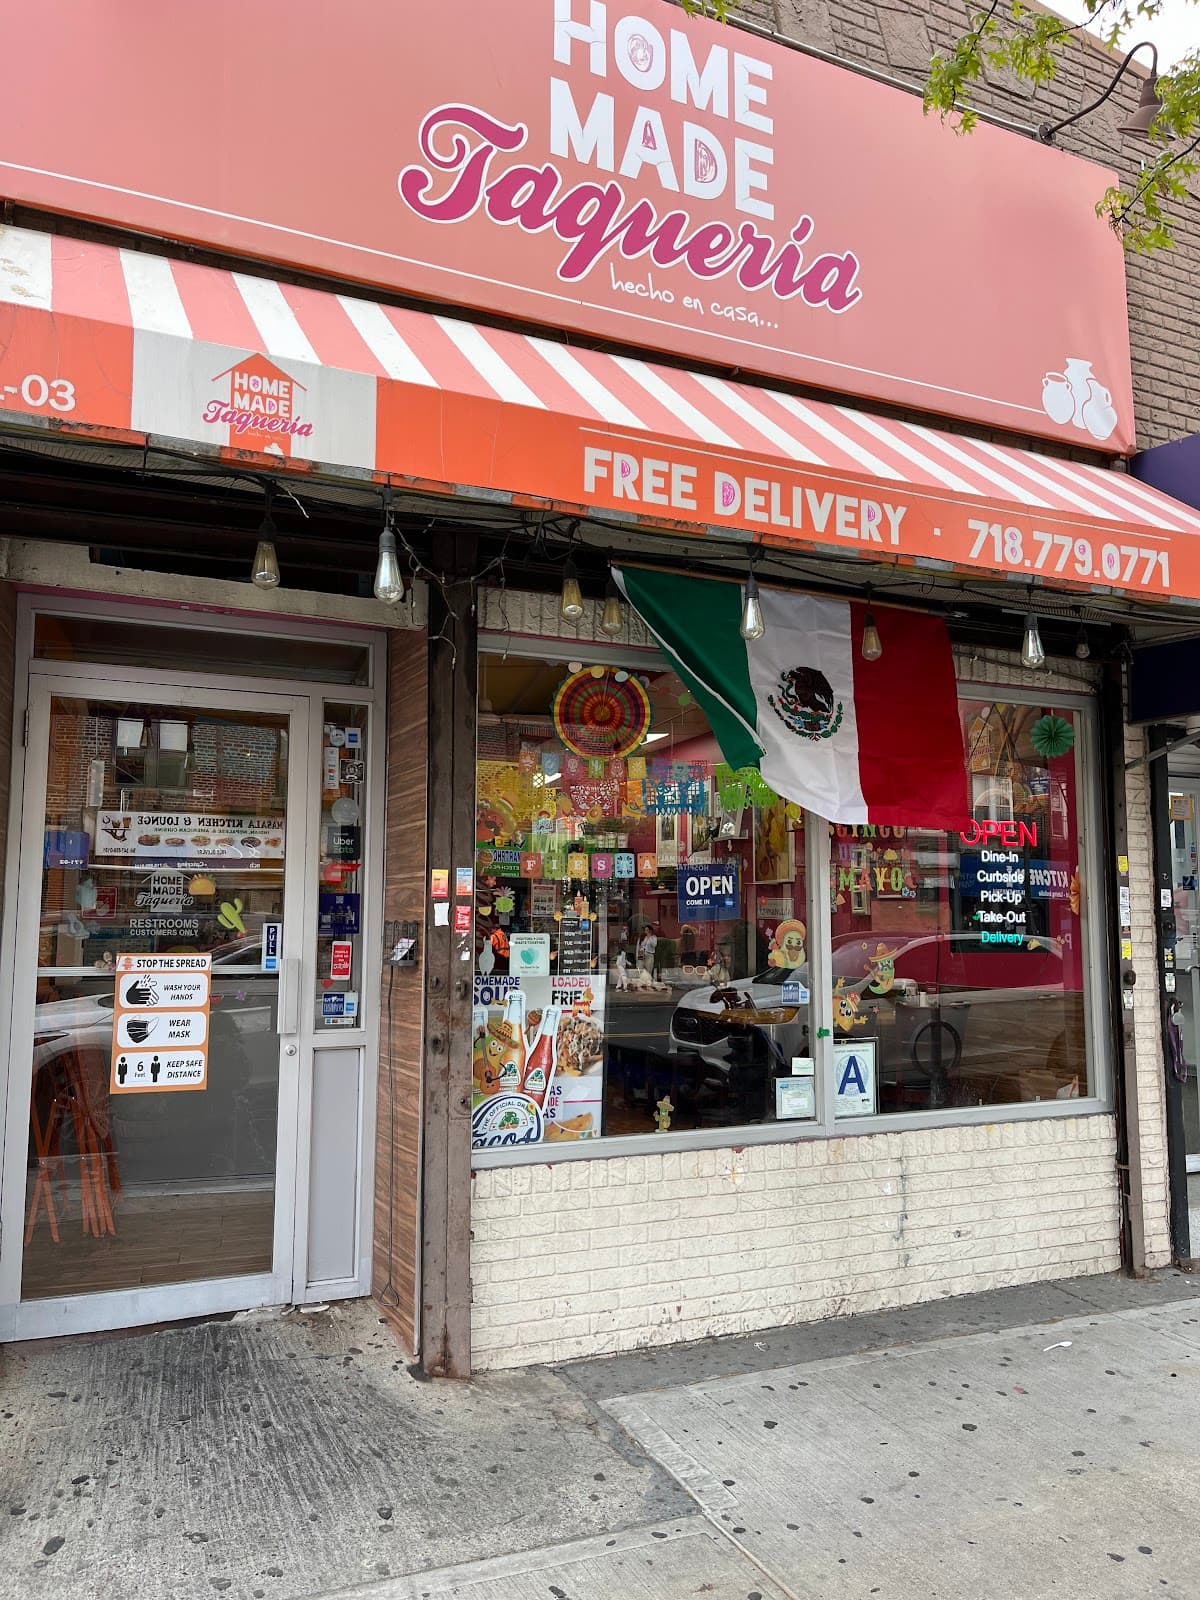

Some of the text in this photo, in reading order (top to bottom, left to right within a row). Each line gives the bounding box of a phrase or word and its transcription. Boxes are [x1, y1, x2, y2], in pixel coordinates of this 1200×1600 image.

[553, 0, 774, 135] HOME
[550, 76, 775, 220] MADE
[398, 102, 863, 314] Taquería
[609, 262, 675, 303] hecho
[682, 296, 705, 315] en
[234, 371, 291, 399] HOME
[0, 374, 76, 412] -03
[233, 391, 290, 418] MADE
[583, 446, 1171, 588] FREE DELIVERY 718.779.0771
[960, 819, 1037, 847] OPEN
[333, 836, 354, 846] Uber
[333, 846, 354, 854] Eats
[981, 850, 1019, 863] Dine-In
[153, 876, 182, 885] HOME
[838, 867, 903, 892] MAYO
[976, 869, 1025, 883] Curbside
[152, 886, 182, 895] MADE
[685, 875, 734, 897] OPEN
[980, 890, 1022, 905] Pick-Up
[129, 918, 199, 928] RESTROOMS
[978, 910, 1026, 923] Take-Out
[129, 928, 199, 937] CUSTOMERS ONLY
[981, 931, 1024, 946] Delivery
[268, 927, 276, 955] PULL
[136, 958, 207, 968] STOP THE SPREAD
[474, 976, 520, 986] OMEMADE
[551, 976, 591, 987] LOADED
[170, 993, 194, 1001] HANDS
[473, 986, 519, 1006] SOU
[551, 990, 593, 1006] FRIE
[169, 1019, 191, 1027] WEAR
[168, 1030, 191, 1038] MASK
[136, 1061, 144, 1072] 6
[166, 1059, 203, 1068] KEEP SAFE
[166, 1070, 202, 1079] DISTANCE
[837, 1055, 867, 1095] A
[482, 1118, 491, 1131] THE
[489, 1101, 516, 1117] OFFICIAL
